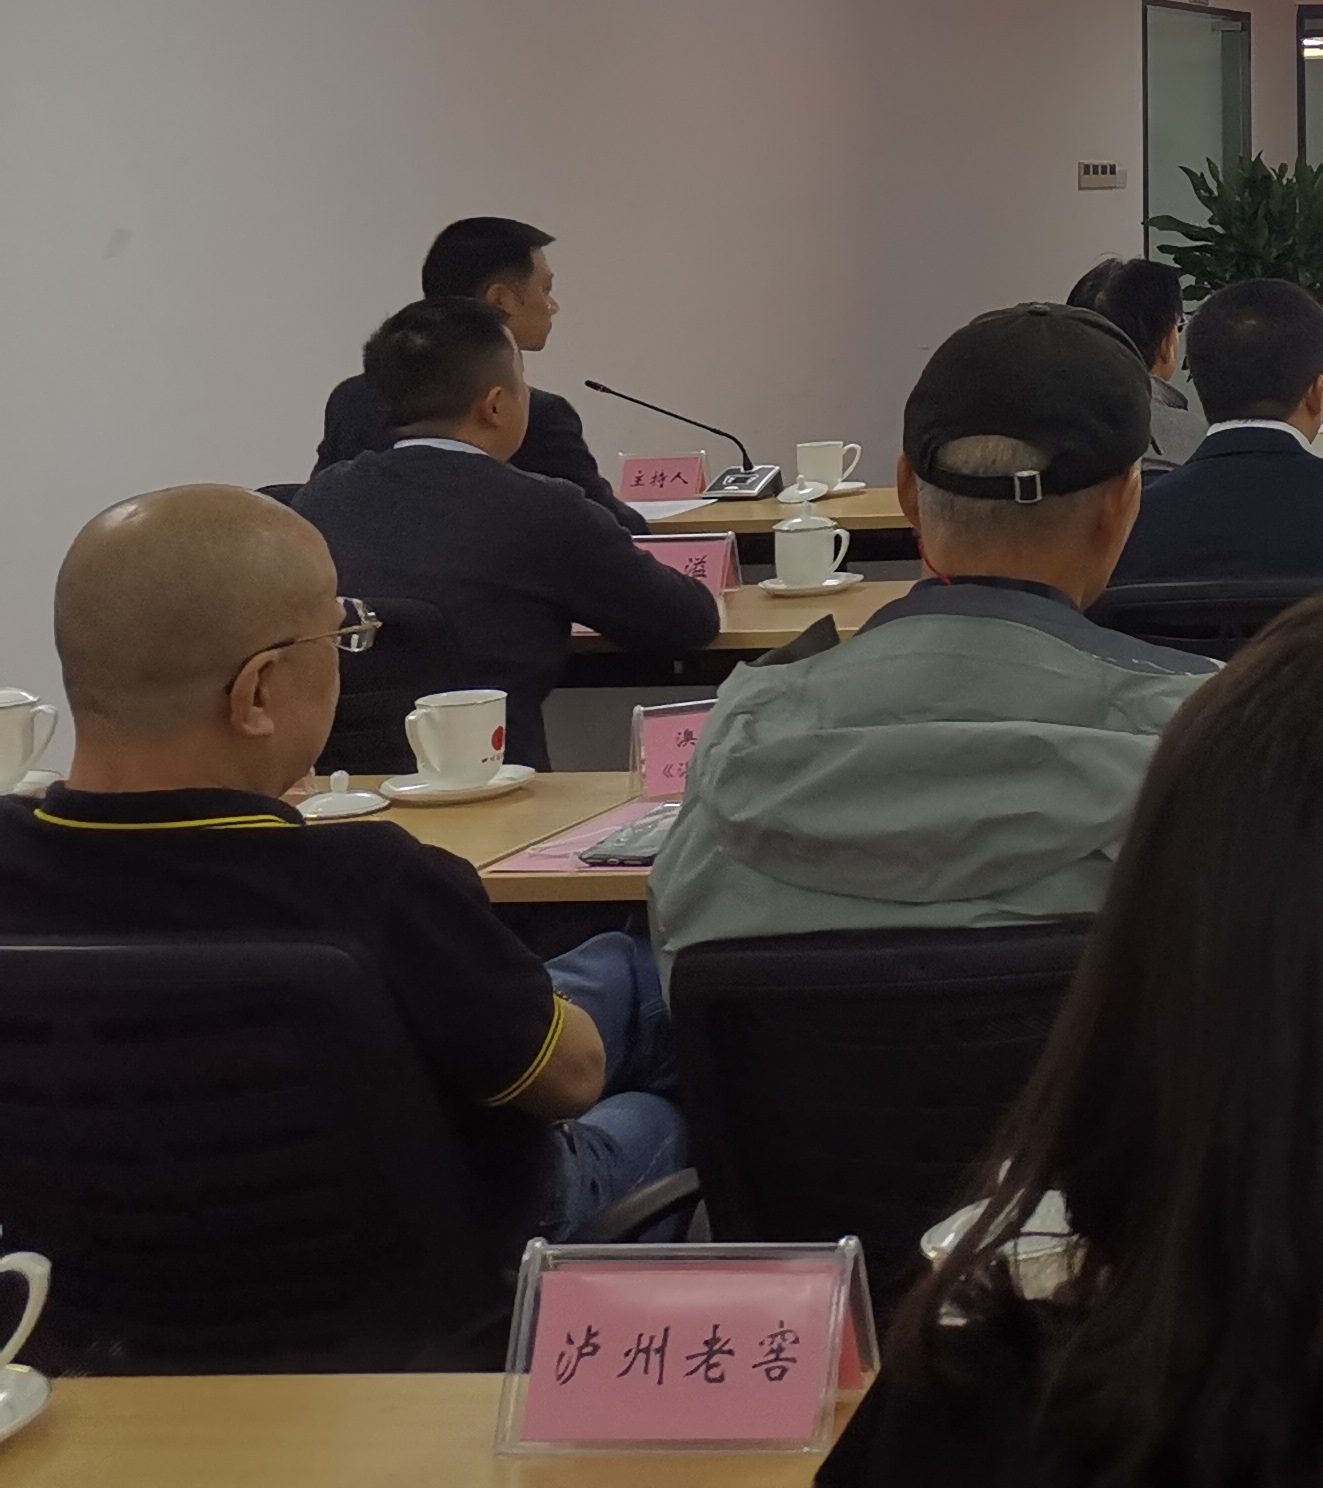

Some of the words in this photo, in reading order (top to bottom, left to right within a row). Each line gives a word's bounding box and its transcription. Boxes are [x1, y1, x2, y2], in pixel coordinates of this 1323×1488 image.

[630, 469, 689, 489] 主持人
[554, 1320, 800, 1386] 泸州老窖
